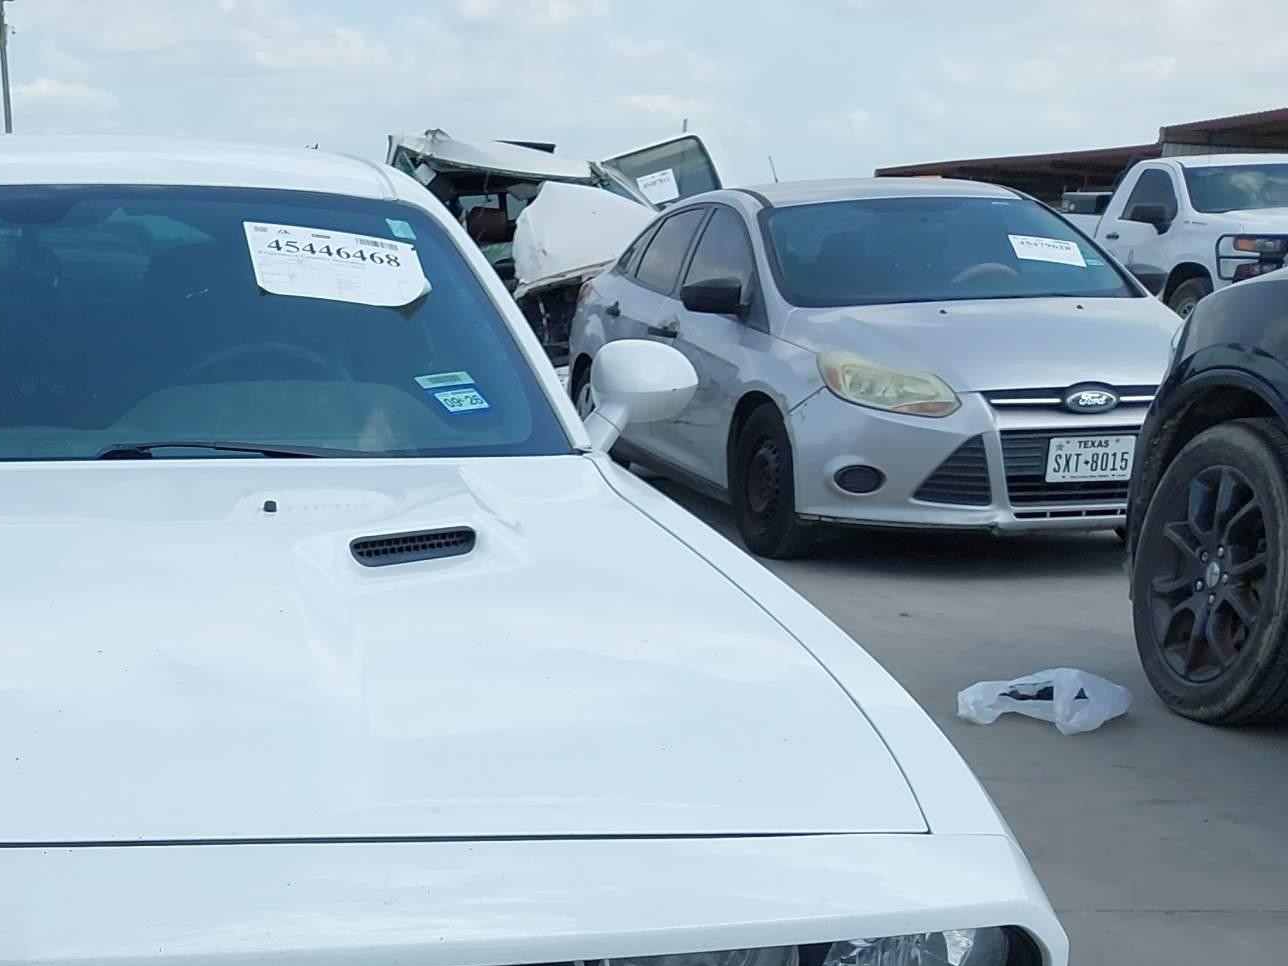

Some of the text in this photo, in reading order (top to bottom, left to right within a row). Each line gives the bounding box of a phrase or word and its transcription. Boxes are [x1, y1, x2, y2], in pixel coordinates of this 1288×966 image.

[267, 239, 401, 268] 45446468
[1079, 391, 1108, 405] Ford
[1078, 439, 1110, 449] TEXAS
